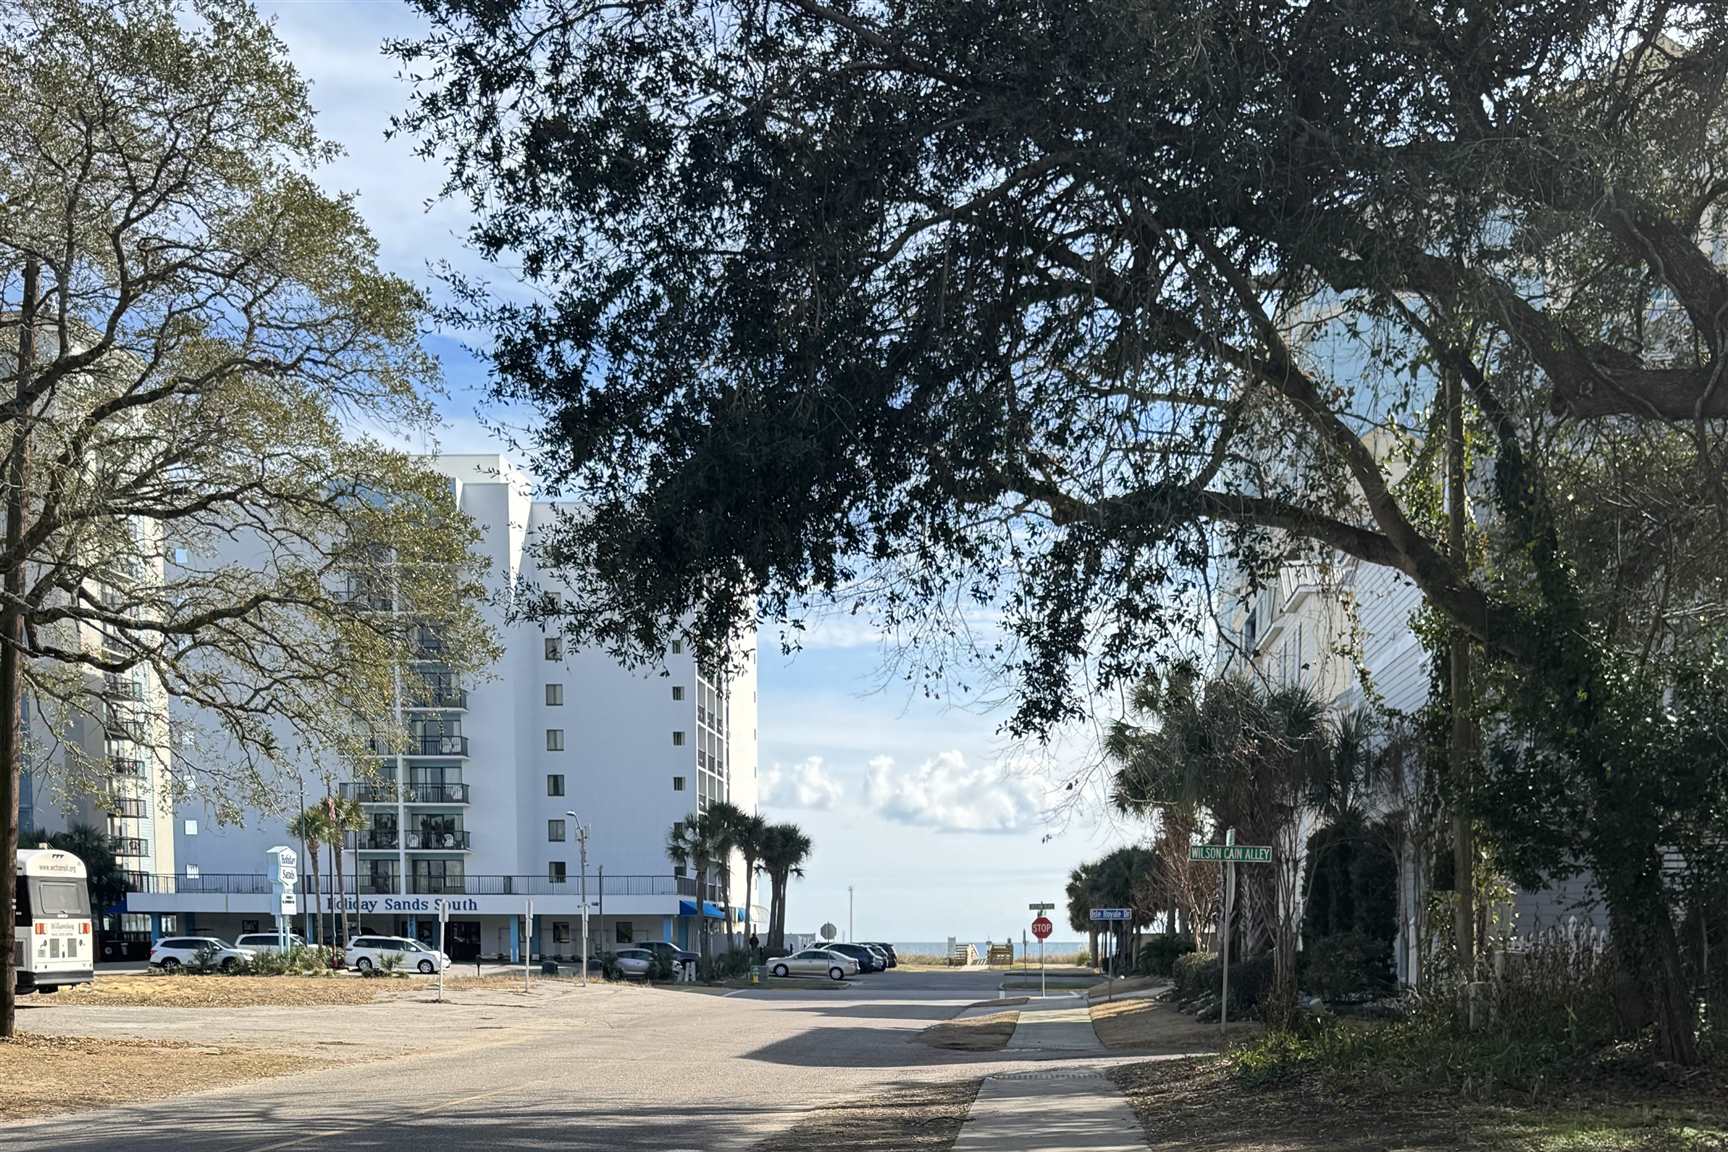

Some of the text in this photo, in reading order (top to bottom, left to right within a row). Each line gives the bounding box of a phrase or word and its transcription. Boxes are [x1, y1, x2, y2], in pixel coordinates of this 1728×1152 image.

[1191, 847, 1270, 860] WILSON CAIN ALLEY
[384, 897, 429, 911] Sands
[1032, 923, 1051, 933] STOP
